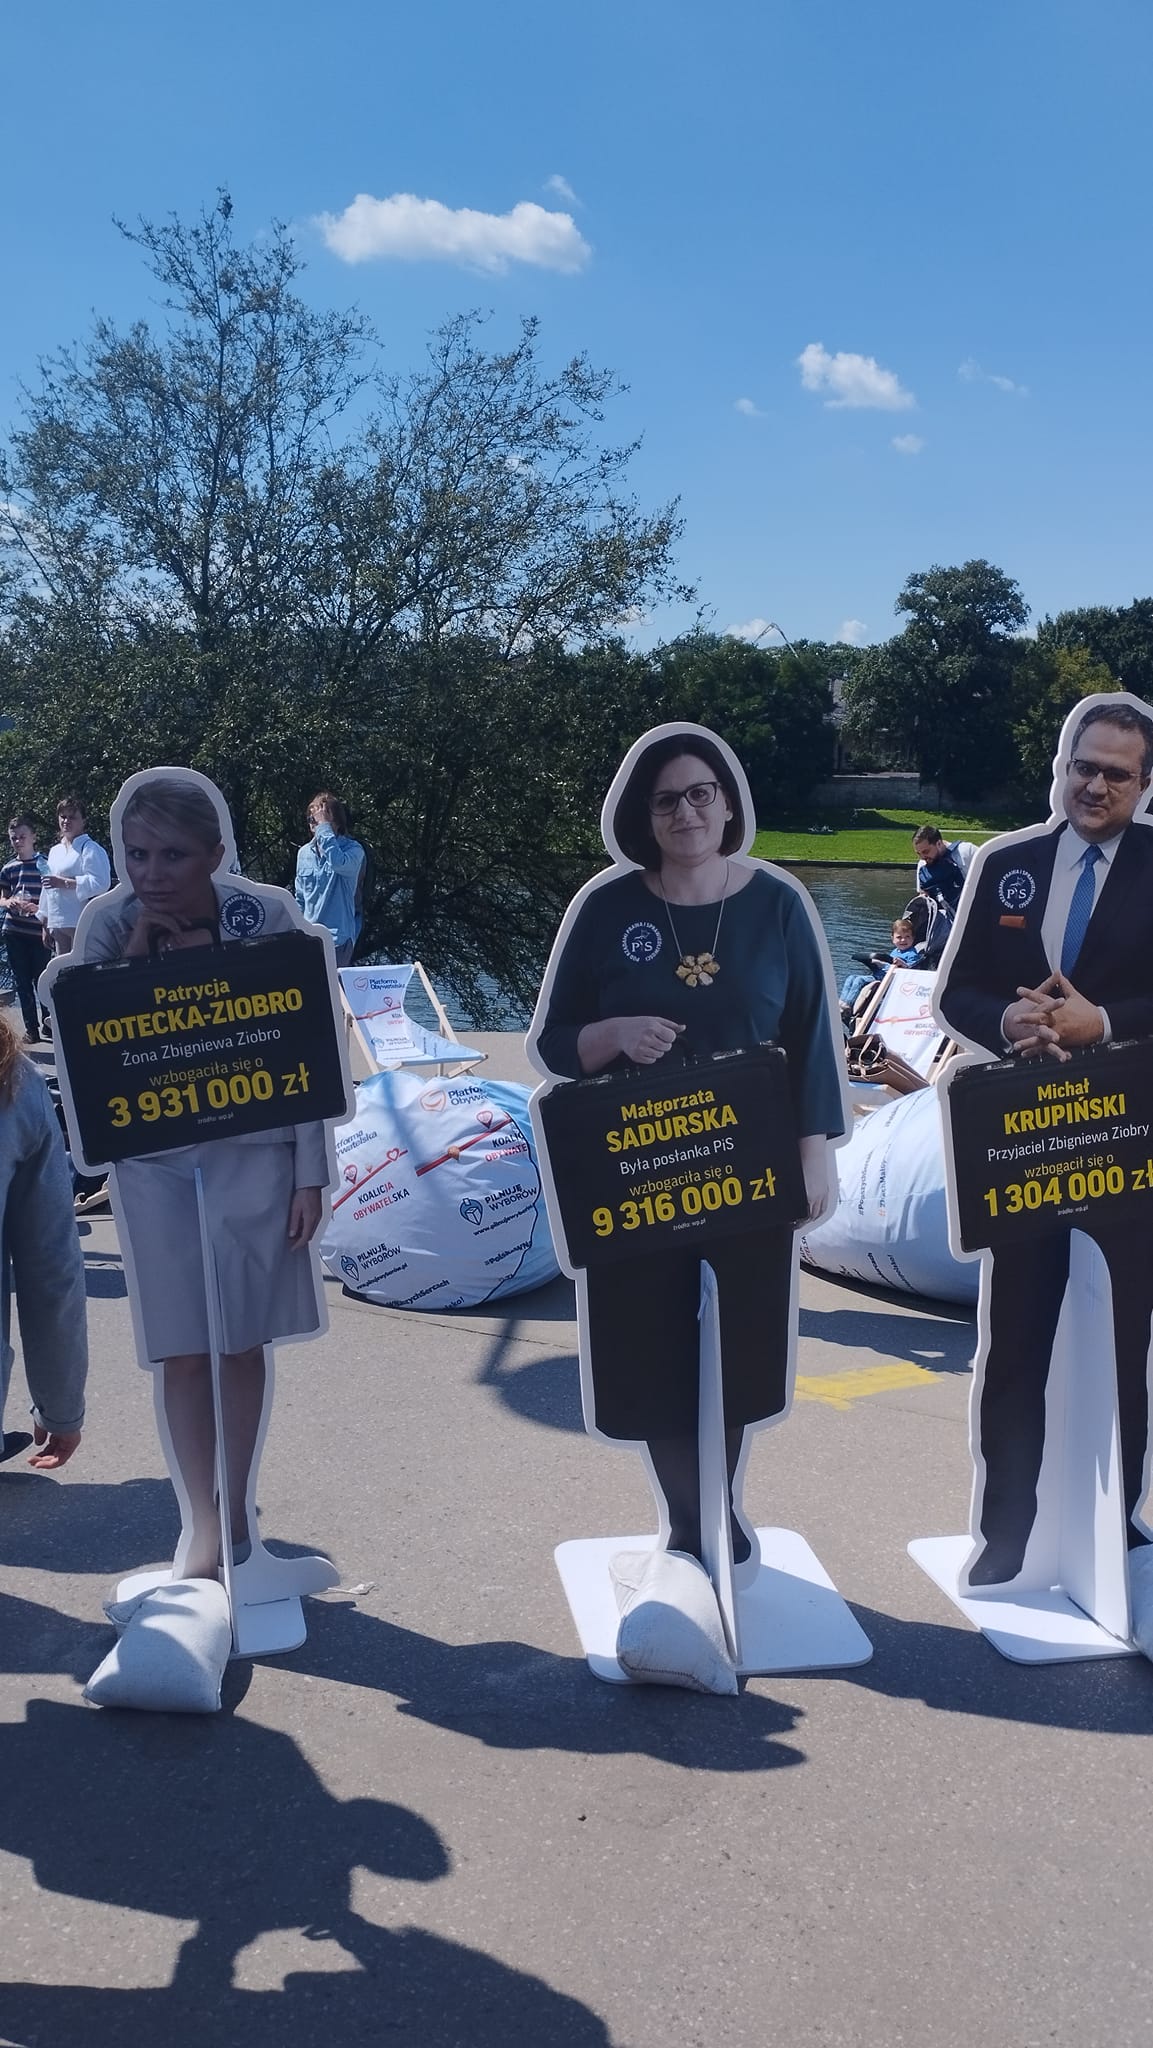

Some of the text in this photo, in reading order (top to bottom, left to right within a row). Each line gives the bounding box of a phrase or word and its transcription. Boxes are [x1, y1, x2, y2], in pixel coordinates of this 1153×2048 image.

[153, 978, 231, 1005] Patrycja
[86, 988, 303, 1046] KOTECKA-ZIOBRO
[121, 1027, 281, 1066] Żona Zbigniewa Ziobro
[149, 1057, 264, 1087] wzbogaciła się o
[107, 1062, 310, 1128] 3 931 000 zł
[1037, 1077, 1090, 1101] Michał
[621, 1089, 716, 1122] Małgorzata
[1003, 1093, 1126, 1135] KRUPIŃSKI
[336, 1130, 364, 1149] tforma
[492, 1132, 524, 1149] KOALIC
[606, 1104, 738, 1153] SADURSKA
[988, 1123, 1150, 1162] Przyjaciel Zbigniewa Ziobry
[336, 1131, 378, 1159] ywatelska
[485, 1143, 528, 1162] OBYWATE
[620, 1136, 735, 1176] Była posłanka PiS
[629, 1164, 733, 1197] wzbogaciła się o
[1024, 1153, 1114, 1178] wzbogacił się o
[358, 1181, 394, 1205] KOALICJA
[485, 1183, 523, 1205] PILNUJĘ
[489, 1187, 538, 1212] WYBORÓW
[592, 1167, 776, 1237] 9 316 000 zł
[983, 1158, 1153, 1217] 1 304 000 zł
[353, 1188, 410, 1221] OBYWATELSKA
[357, 1242, 387, 1263] PILNUJĘ
[361, 1245, 401, 1270] WYBORÓW
